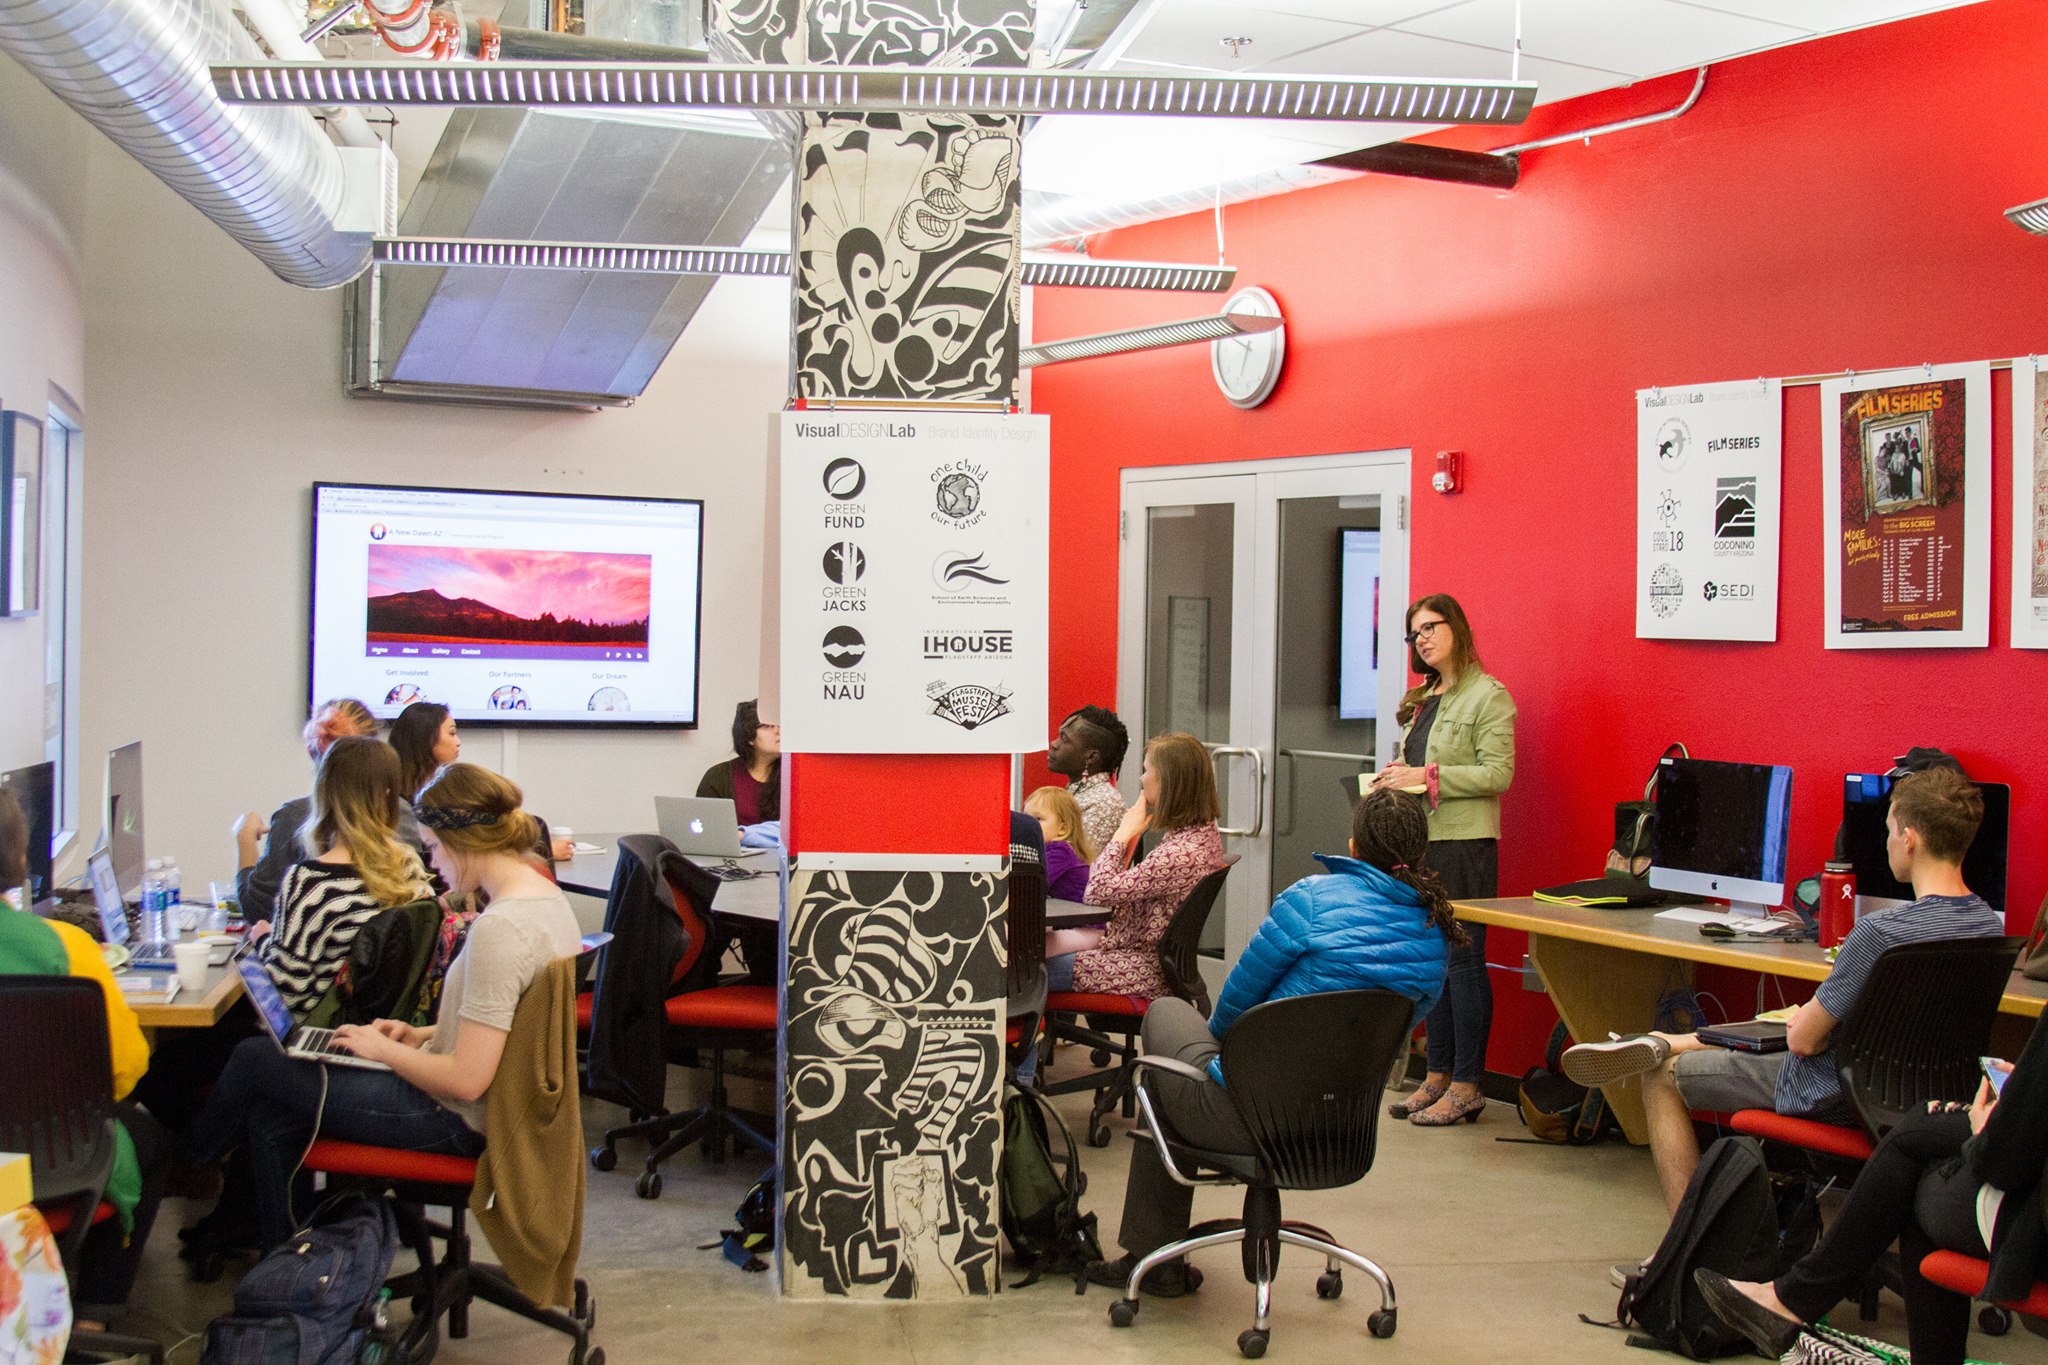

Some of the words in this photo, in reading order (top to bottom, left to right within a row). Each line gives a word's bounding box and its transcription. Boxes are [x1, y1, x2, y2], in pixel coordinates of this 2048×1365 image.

[1857, 393, 1890, 420] FILM
[1891, 389, 1943, 414] SERIES
[928, 425, 959, 440] Brand
[962, 425, 998, 441] Identity
[1002, 426, 1037, 443] Design
[1707, 437, 1728, 453] FILM
[1728, 436, 1760, 450] SERIES
[930, 463, 953, 482] one
[956, 458, 989, 483] child
[823, 503, 866, 515] GREEN
[825, 516, 865, 529] FUND
[930, 511, 950, 526] our
[954, 509, 987, 531] future
[1910, 520, 1936, 528] SCREEN
[1670, 530, 1684, 552] 18
[1843, 529, 1866, 542] MORE
[1713, 541, 1755, 550] COCONINO
[822, 586, 867, 598] GREEN
[1720, 584, 1754, 597] SEDI
[822, 600, 866, 611] JACKS
[1903, 613, 1919, 622] FREE
[1919, 610, 1957, 621] ADMISSION
[385, 669, 398, 677] Get
[399, 669, 429, 677] Involved
[592, 672, 604, 680] Our
[822, 671, 866, 683] GREEN
[823, 684, 865, 700] NAU
[951, 687, 990, 699] FLAGSTAFF
[952, 696, 988, 708] MUSIC
[955, 705, 985, 719] FEST
